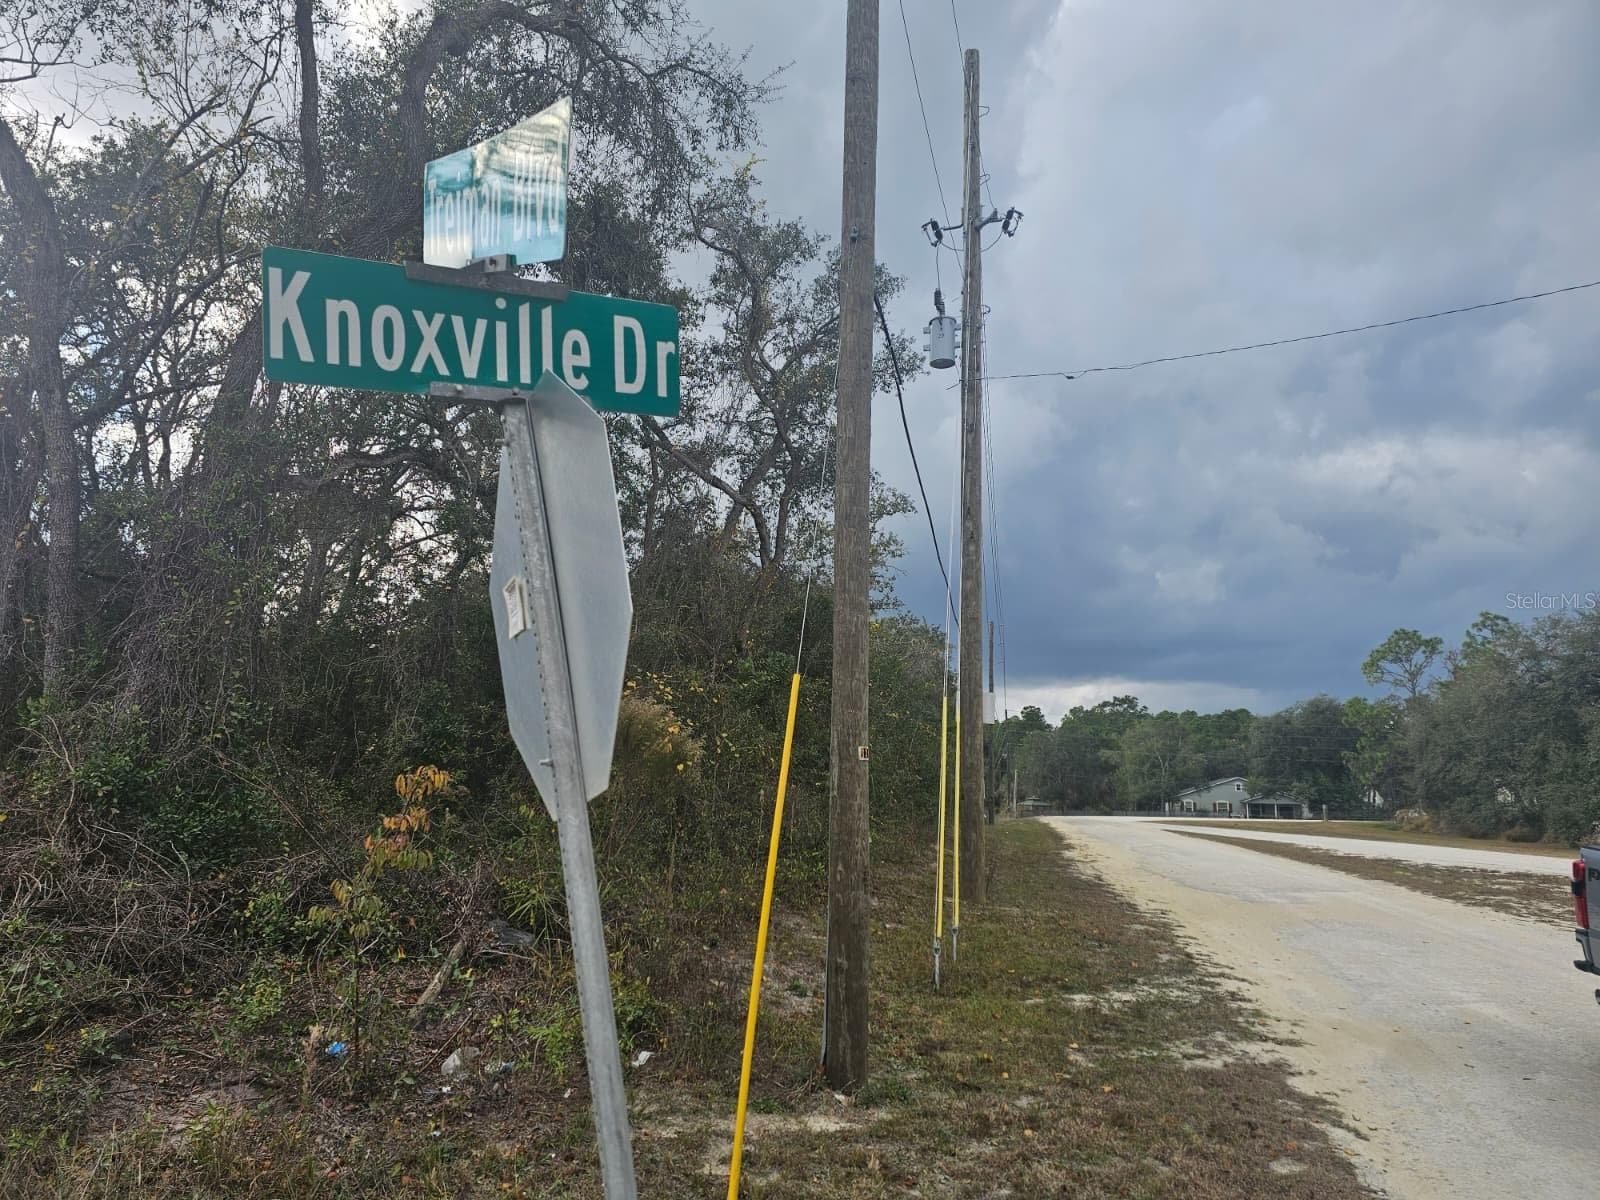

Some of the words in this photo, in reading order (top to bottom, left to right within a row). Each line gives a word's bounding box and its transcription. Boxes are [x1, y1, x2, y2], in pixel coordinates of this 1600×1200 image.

[513, 135, 561, 241] Blvd
[268, 266, 591, 391] Knoxville
[613, 315, 676, 398] Dr
